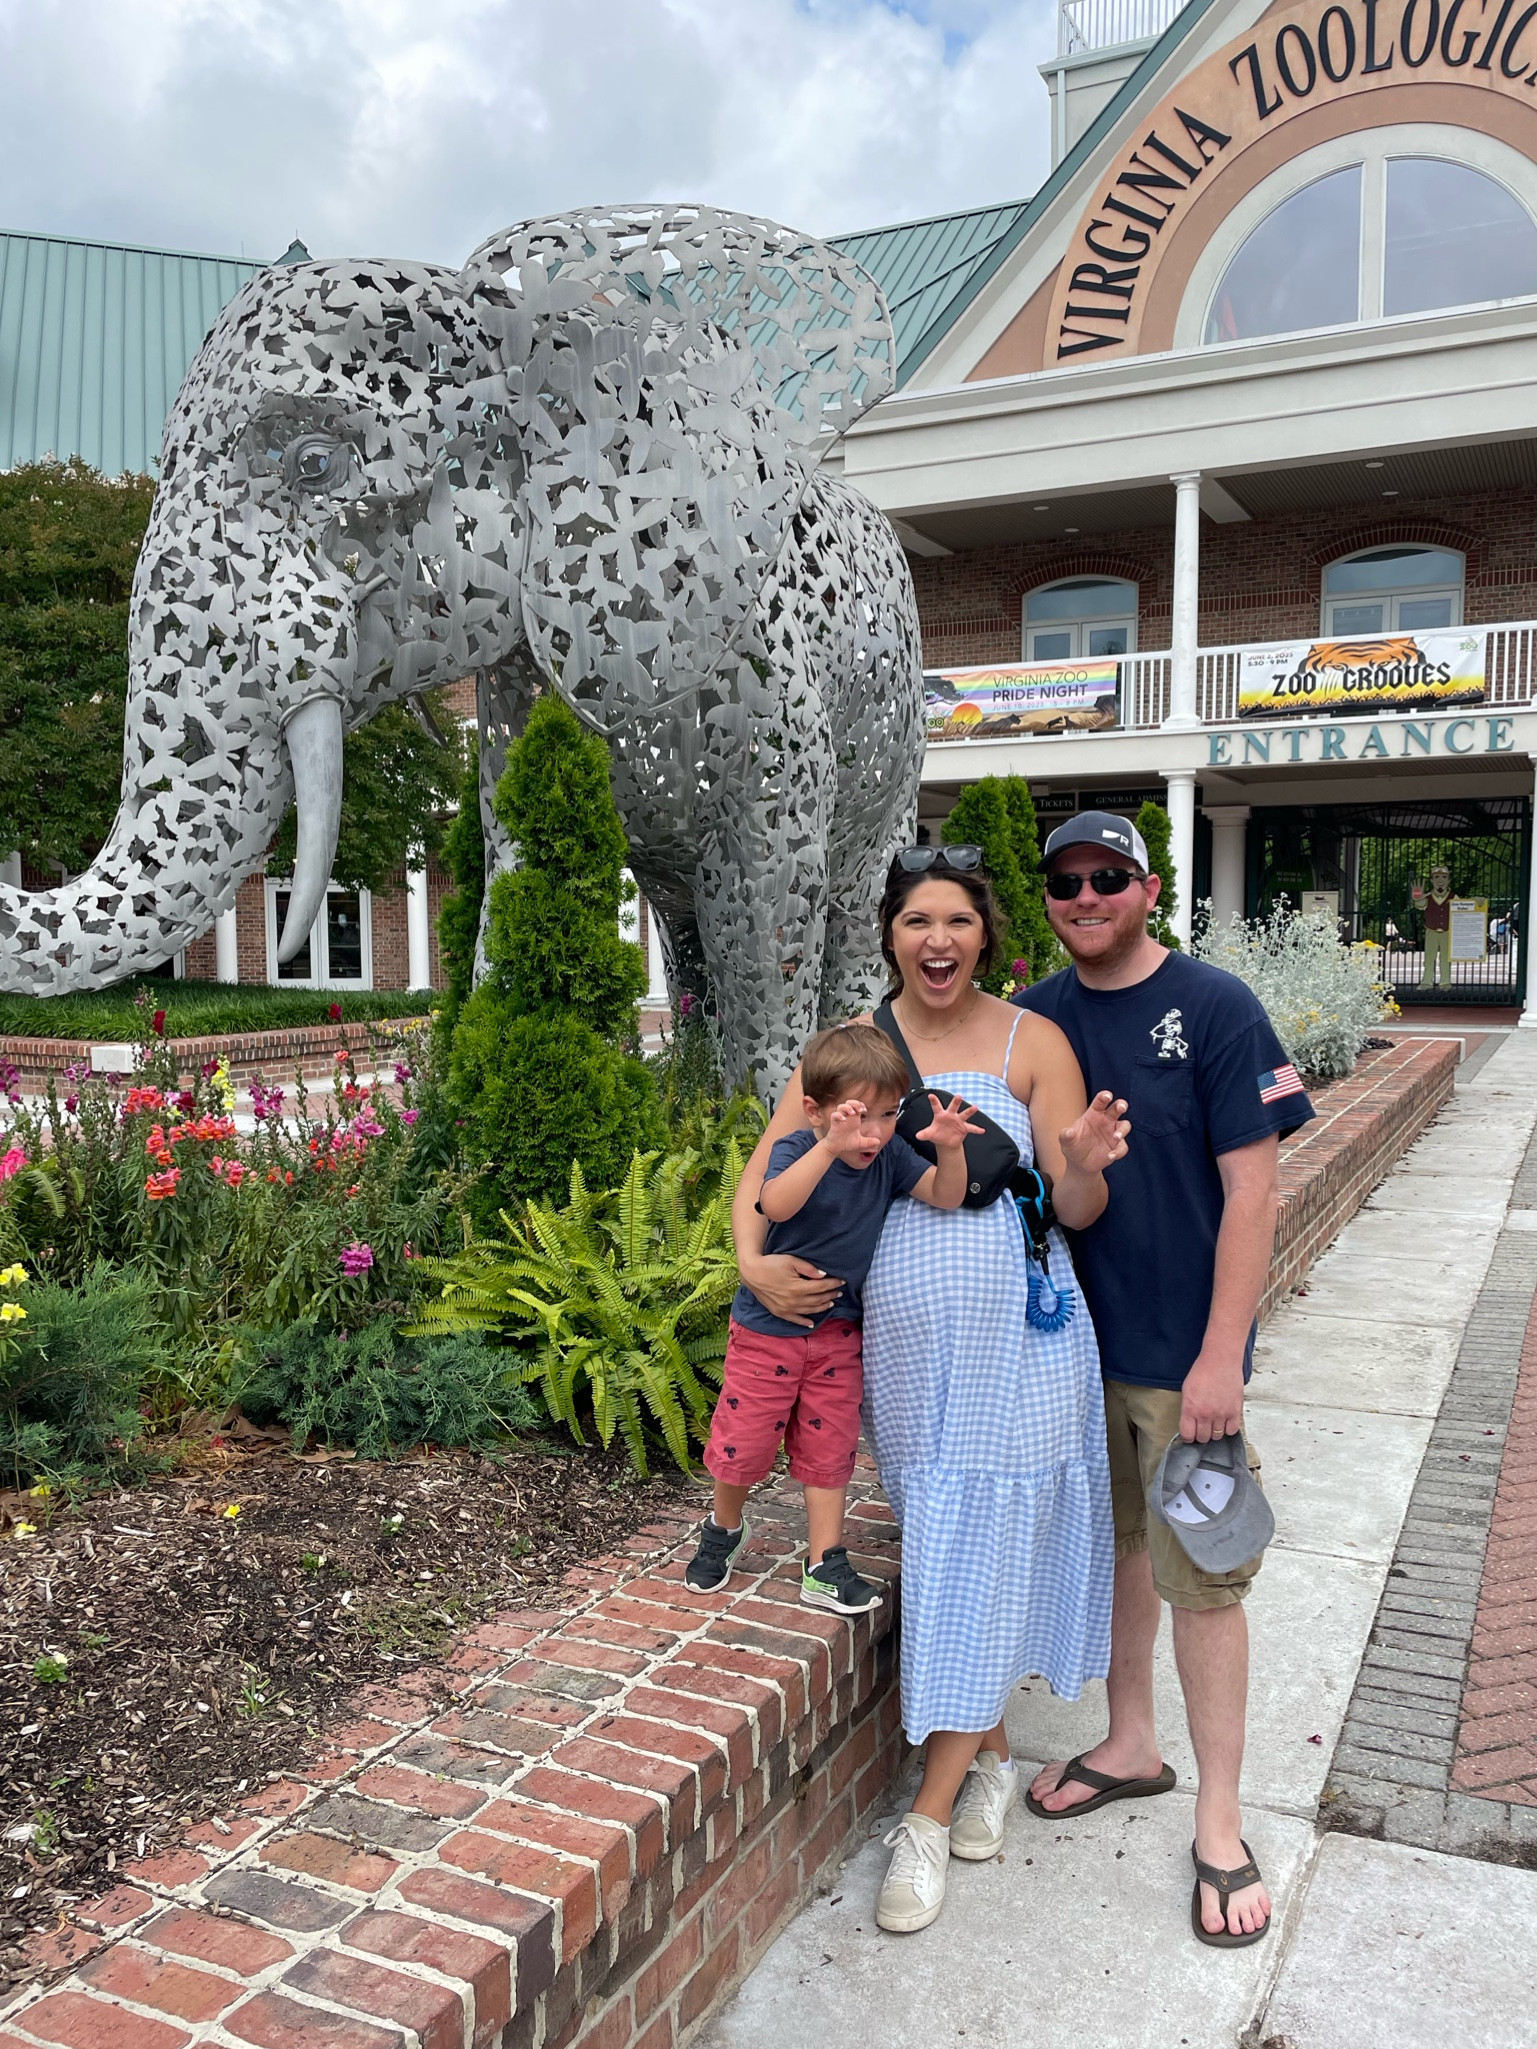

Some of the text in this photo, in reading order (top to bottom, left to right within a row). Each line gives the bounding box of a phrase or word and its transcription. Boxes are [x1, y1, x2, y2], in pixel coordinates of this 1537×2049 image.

[1057, 0, 1537, 360] VIRGINIA ZOOLOGIC
[993, 670, 1088, 689] VIRGINIA ZOO
[1272, 661, 1451, 697] ZOO GROOVES
[992, 684, 1088, 703] PRIDE NIGHT
[992, 704, 1013, 712] JUNE
[1206, 717, 1515, 765] ENTRANCE
[1095, 795, 1133, 805] GENERAL
